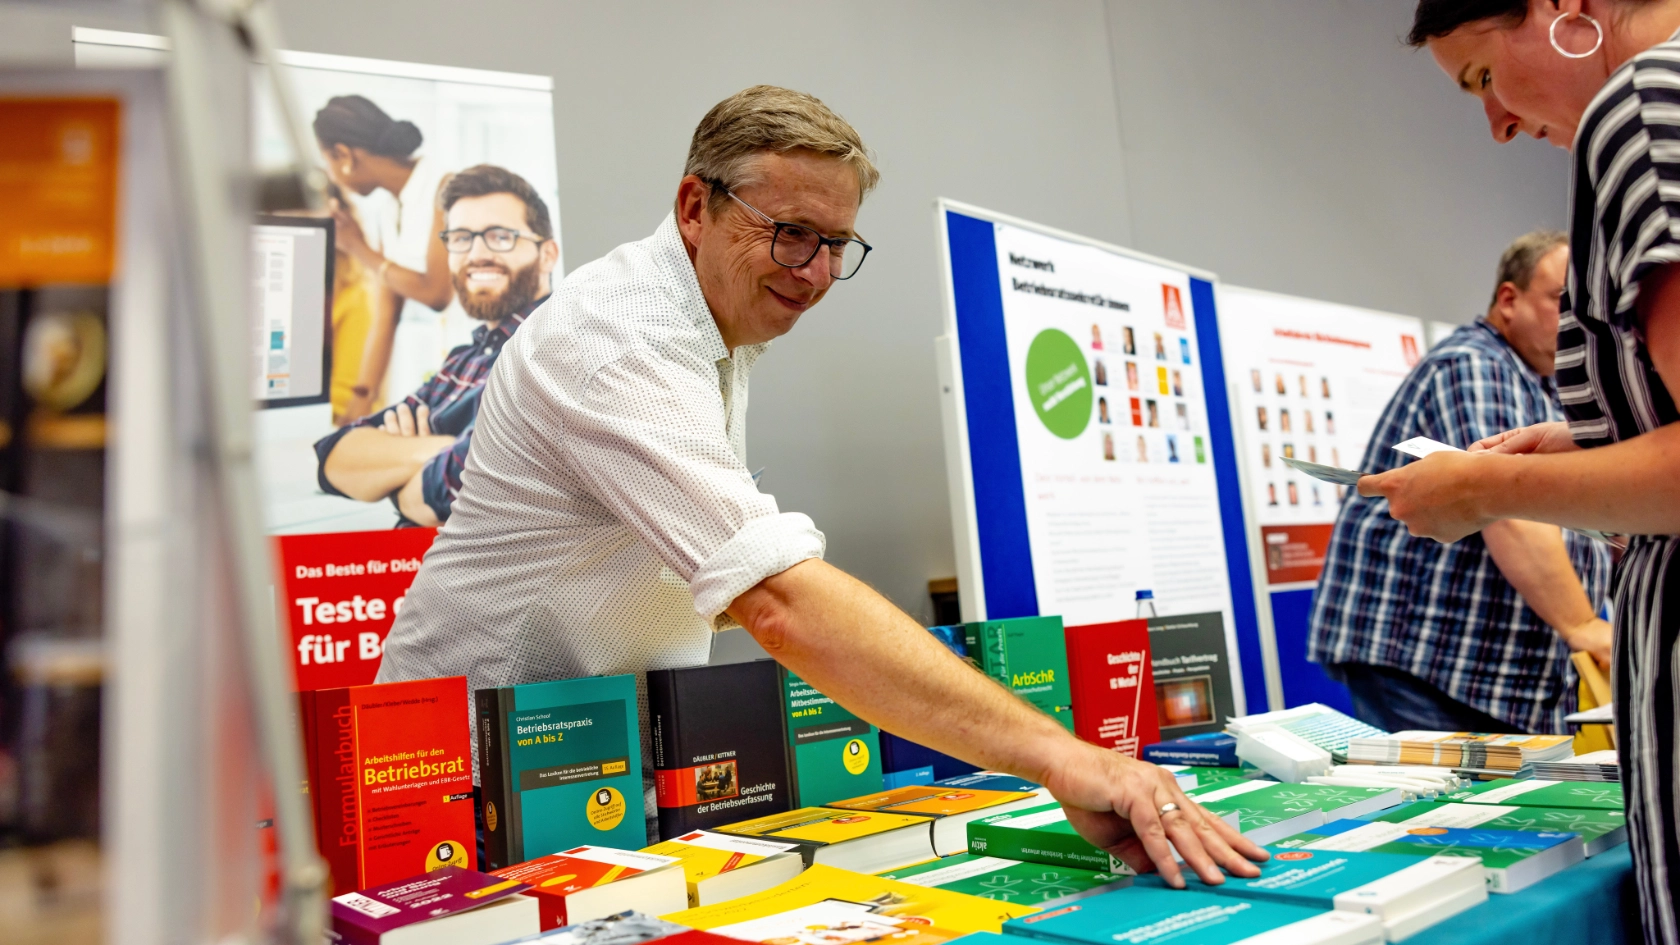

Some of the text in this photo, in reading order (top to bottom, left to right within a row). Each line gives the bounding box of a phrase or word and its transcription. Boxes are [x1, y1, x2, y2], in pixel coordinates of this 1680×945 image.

[296, 565, 323, 579] Das
[325, 562, 365, 577] Beste
[366, 560, 389, 574] für
[295, 595, 387, 625] Teste
[297, 634, 351, 666] für
[1012, 669, 1055, 687] ArbSchR
[792, 710, 802, 718] von
[517, 717, 593, 735] Betriebsratspraxis
[517, 733, 564, 747] von A bis Z
[364, 748, 445, 765] Arbeitshilfen für den
[332, 704, 357, 847] Formularbuch
[364, 756, 465, 786] Betriebsrat
[383, 781, 428, 793] Wahlunterlagen
[429, 778, 440, 786] und
[740, 782, 776, 795] Geschichte
[697, 793, 773, 814] der Betriebsverfassung
[971, 841, 987, 851] aktiv
